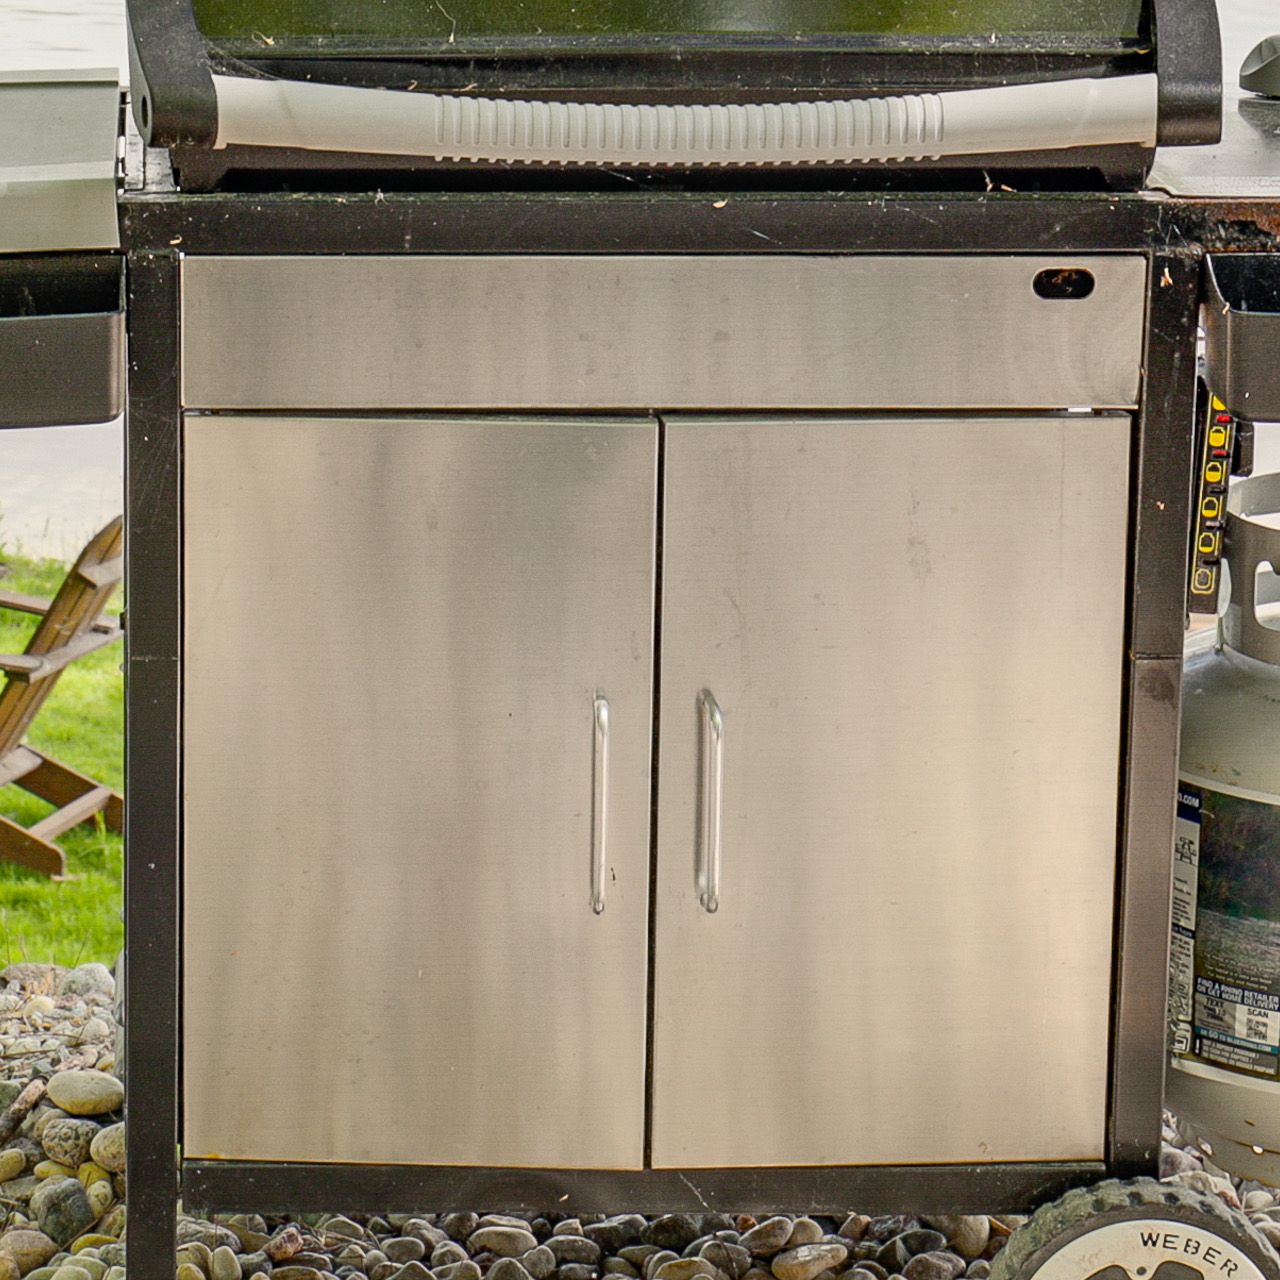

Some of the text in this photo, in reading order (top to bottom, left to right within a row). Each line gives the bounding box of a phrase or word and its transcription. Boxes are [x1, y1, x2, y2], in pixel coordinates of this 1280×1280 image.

[1243, 996, 1280, 1011] DELIVERY
[1244, 988, 1280, 1004] RETAILER
[1247, 1007, 1269, 1019] SCAN
[1140, 1231, 1239, 1278] WEBER
